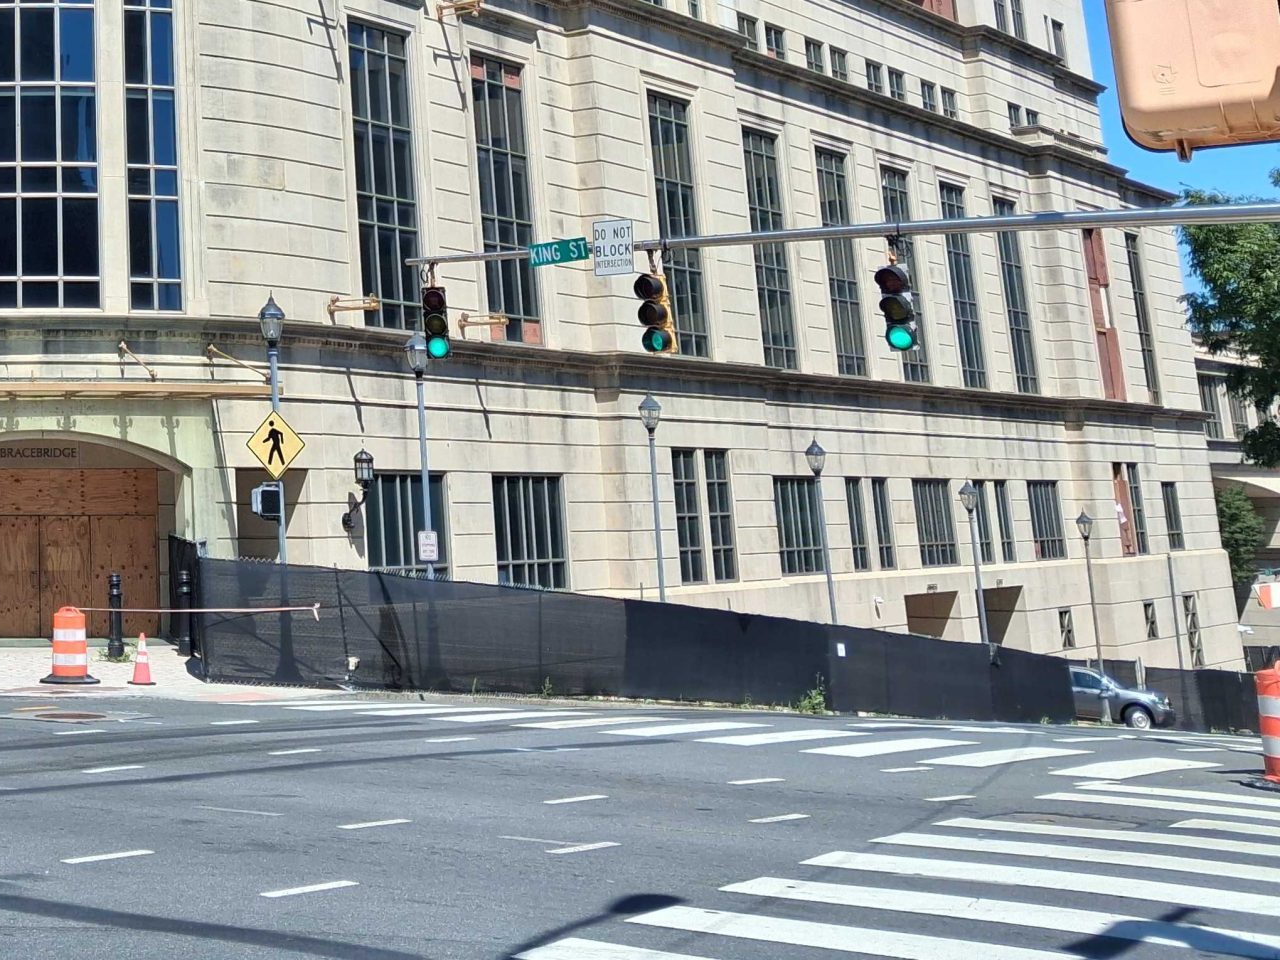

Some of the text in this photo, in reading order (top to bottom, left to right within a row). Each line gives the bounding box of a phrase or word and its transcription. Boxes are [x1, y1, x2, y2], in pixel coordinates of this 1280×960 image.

[595, 226, 631, 241] DO NOT
[530, 240, 586, 264] KING ST
[595, 243, 631, 258] BLOCK
[596, 258, 632, 269] INTERSECTION
[0, 447, 78, 459] BRACEBRIDGE
